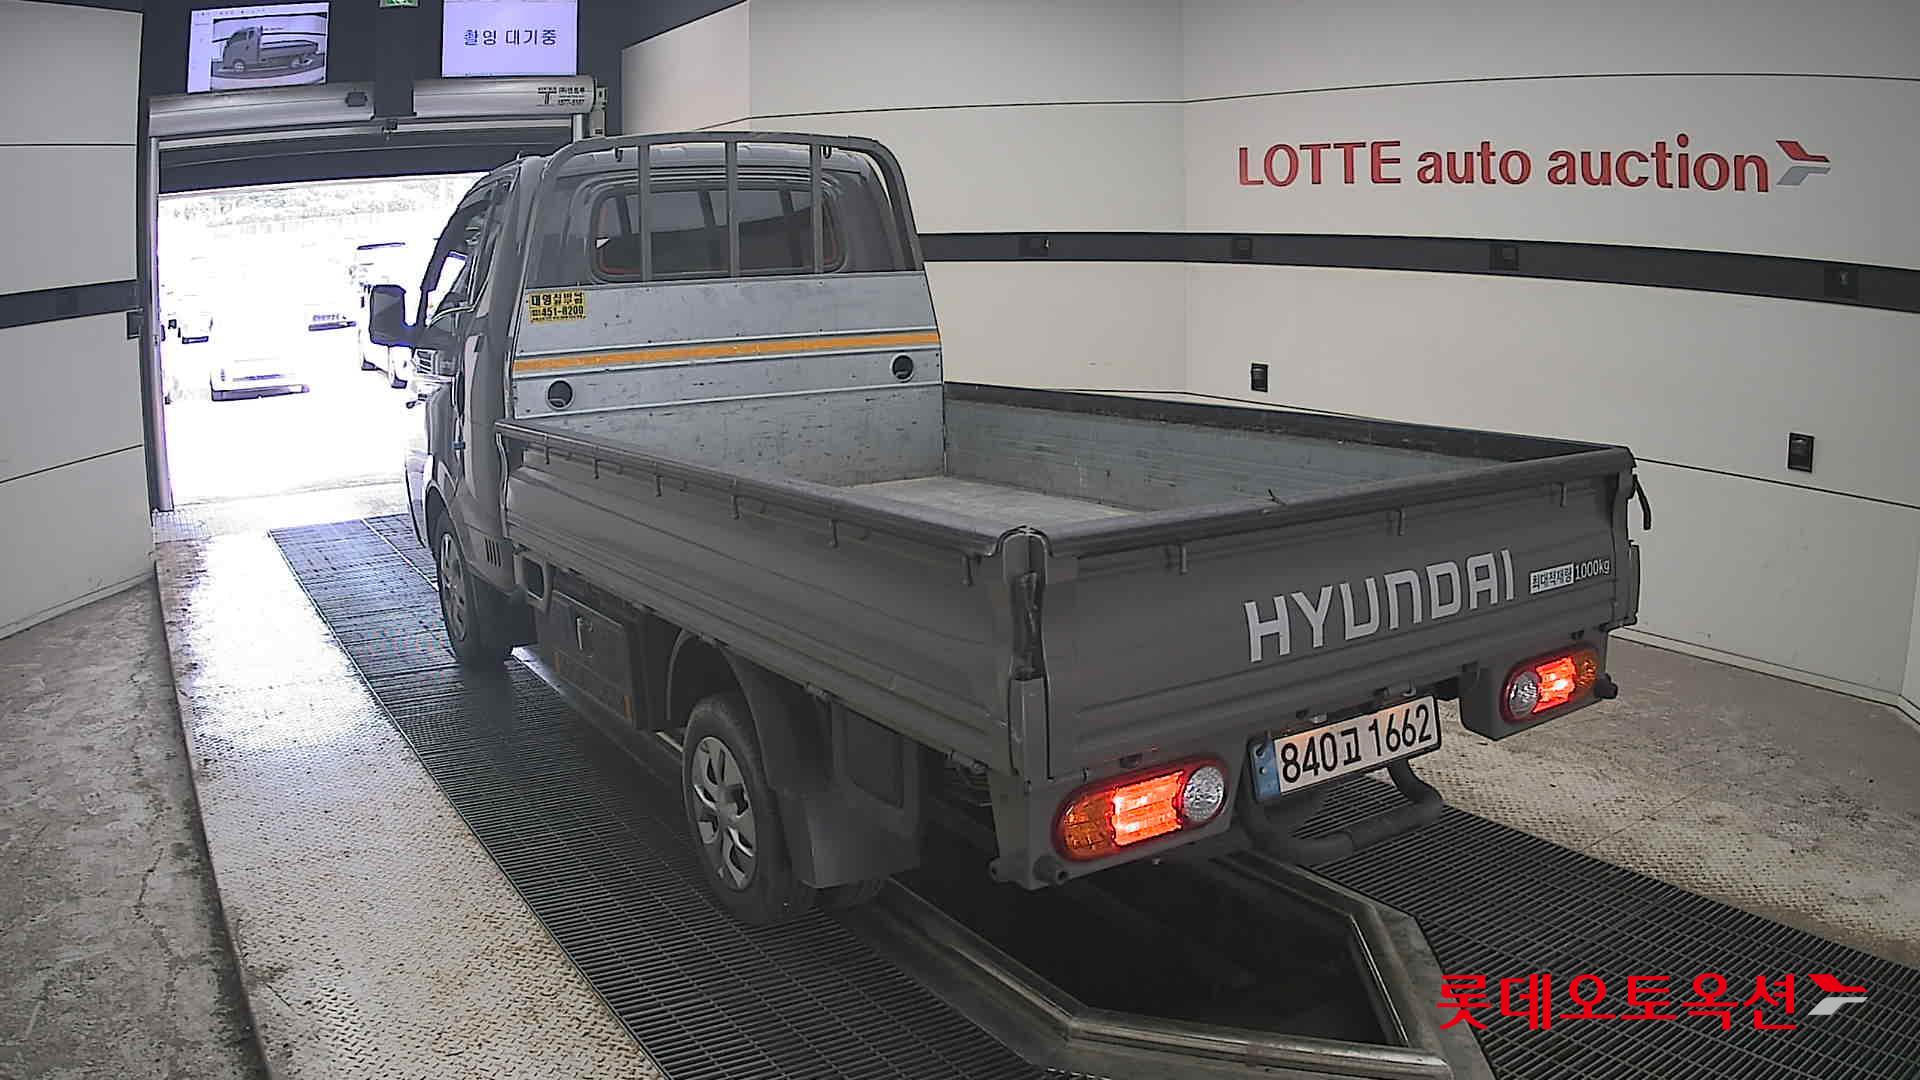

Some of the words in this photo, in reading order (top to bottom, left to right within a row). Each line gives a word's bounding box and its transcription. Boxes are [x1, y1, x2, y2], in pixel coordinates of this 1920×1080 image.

[505, 29, 557, 46] 대기중
[1239, 140, 1401, 187] LOTTE
[1416, 140, 1532, 186] auto
[1547, 133, 1770, 193] auction
[1574, 559, 1611, 582] 1000kg
[1243, 549, 1516, 663] HYUNDAI
[1280, 727, 1362, 784] 840고
[1367, 703, 1433, 757] 1662
